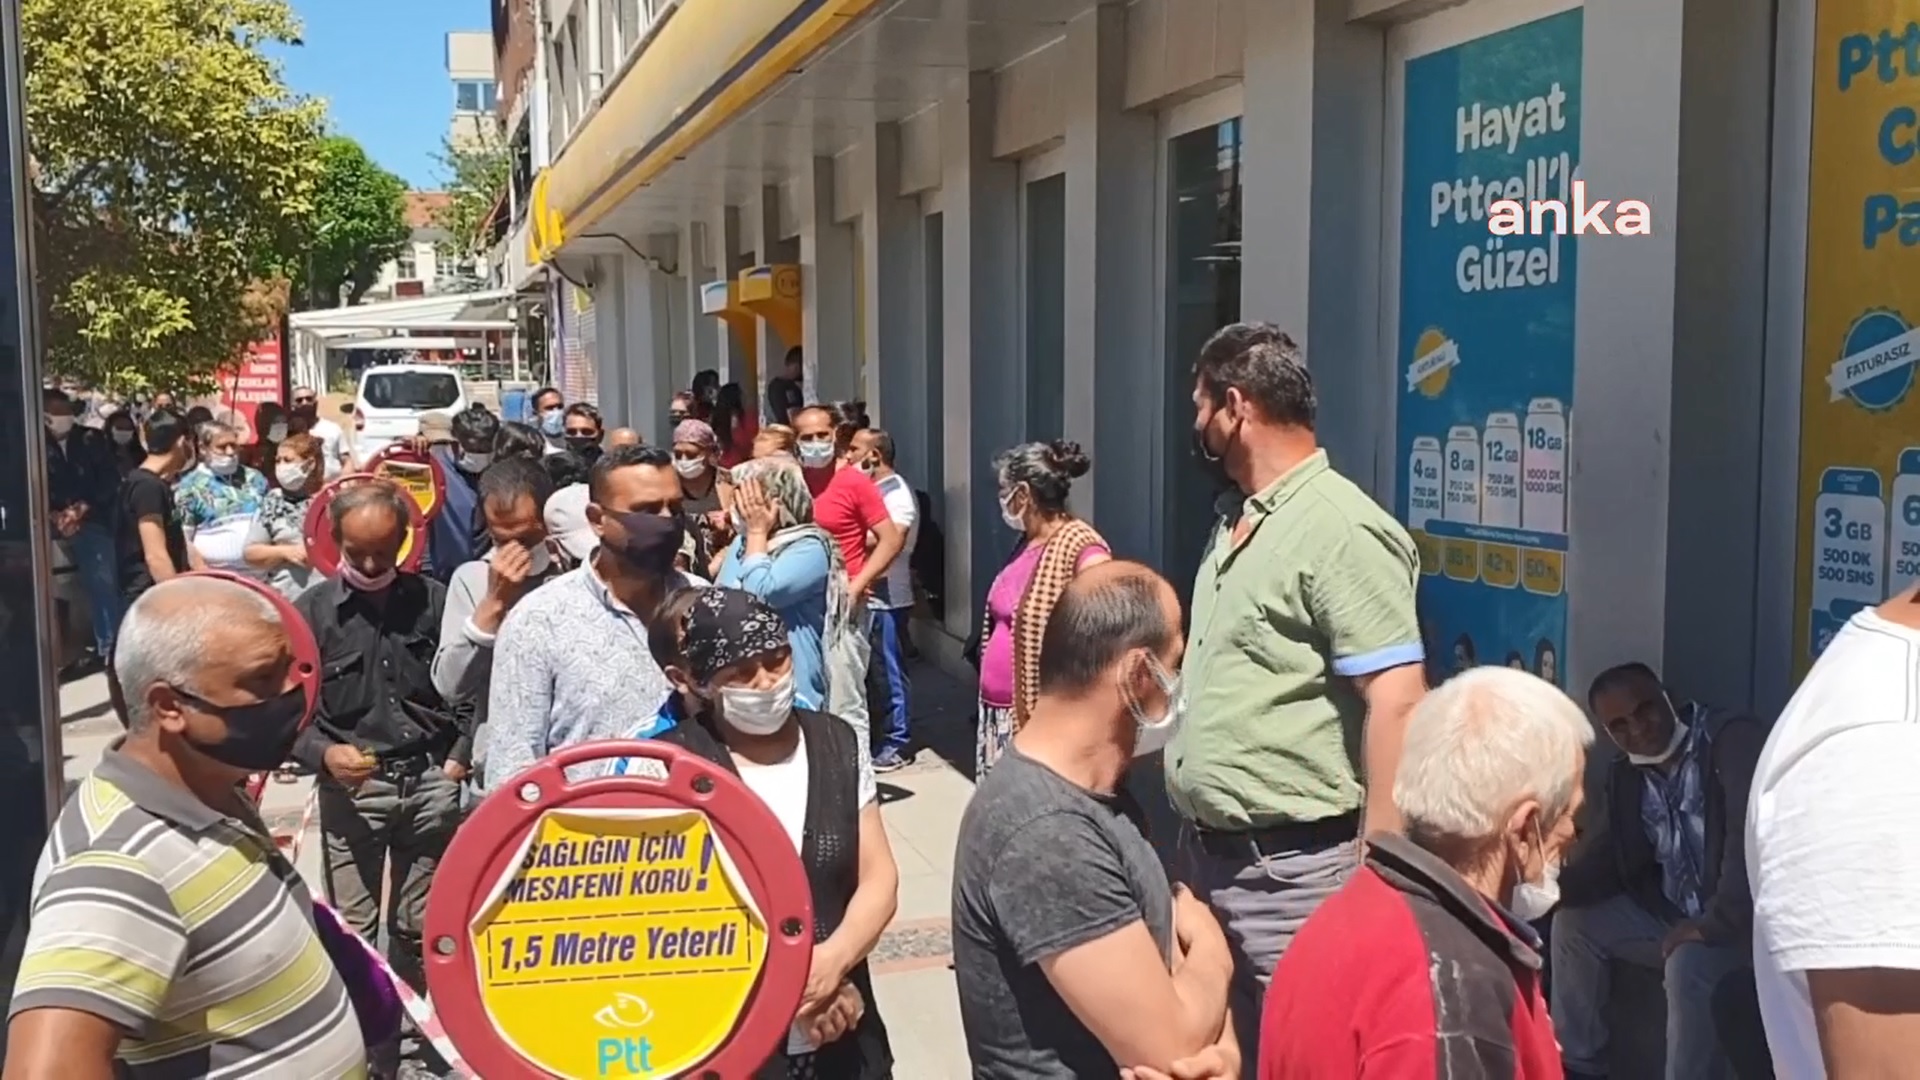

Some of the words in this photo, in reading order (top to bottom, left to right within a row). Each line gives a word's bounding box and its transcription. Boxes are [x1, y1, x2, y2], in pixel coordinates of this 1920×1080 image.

[1456, 82, 1566, 154] Hayat
[1878, 106, 1920, 165] C
[1456, 231, 1560, 293] Güzel
[1846, 342, 1911, 380] FATURASIZ
[1486, 440, 1503, 461] 12
[1504, 450, 1519, 463] GB
[1527, 426, 1546, 449] 18
[1547, 436, 1562, 450] GB
[1413, 458, 1423, 478] 4
[1424, 467, 1437, 479] GB
[1450, 450, 1460, 471] 8
[1461, 459, 1475, 471] GB
[1526, 468, 1547, 480] 1000
[1524, 481, 1545, 493] 1000
[1824, 507, 1842, 538] 3
[1846, 521, 1872, 540] GB
[1823, 547, 1849, 564] 500
[1851, 551, 1871, 567] DK
[1818, 565, 1845, 581] 500
[1846, 568, 1874, 586] SMS
[522, 833, 630, 869] SAĞLIĞIN
[637, 829, 686, 864] İÇİN
[504, 866, 624, 903] MESAFENİ
[630, 867, 692, 895] KORU
[500, 936, 544, 974] 1,5
[550, 933, 637, 968] Metre
[647, 923, 738, 960] Yeterli
[597, 1036, 654, 1076] Ptt
